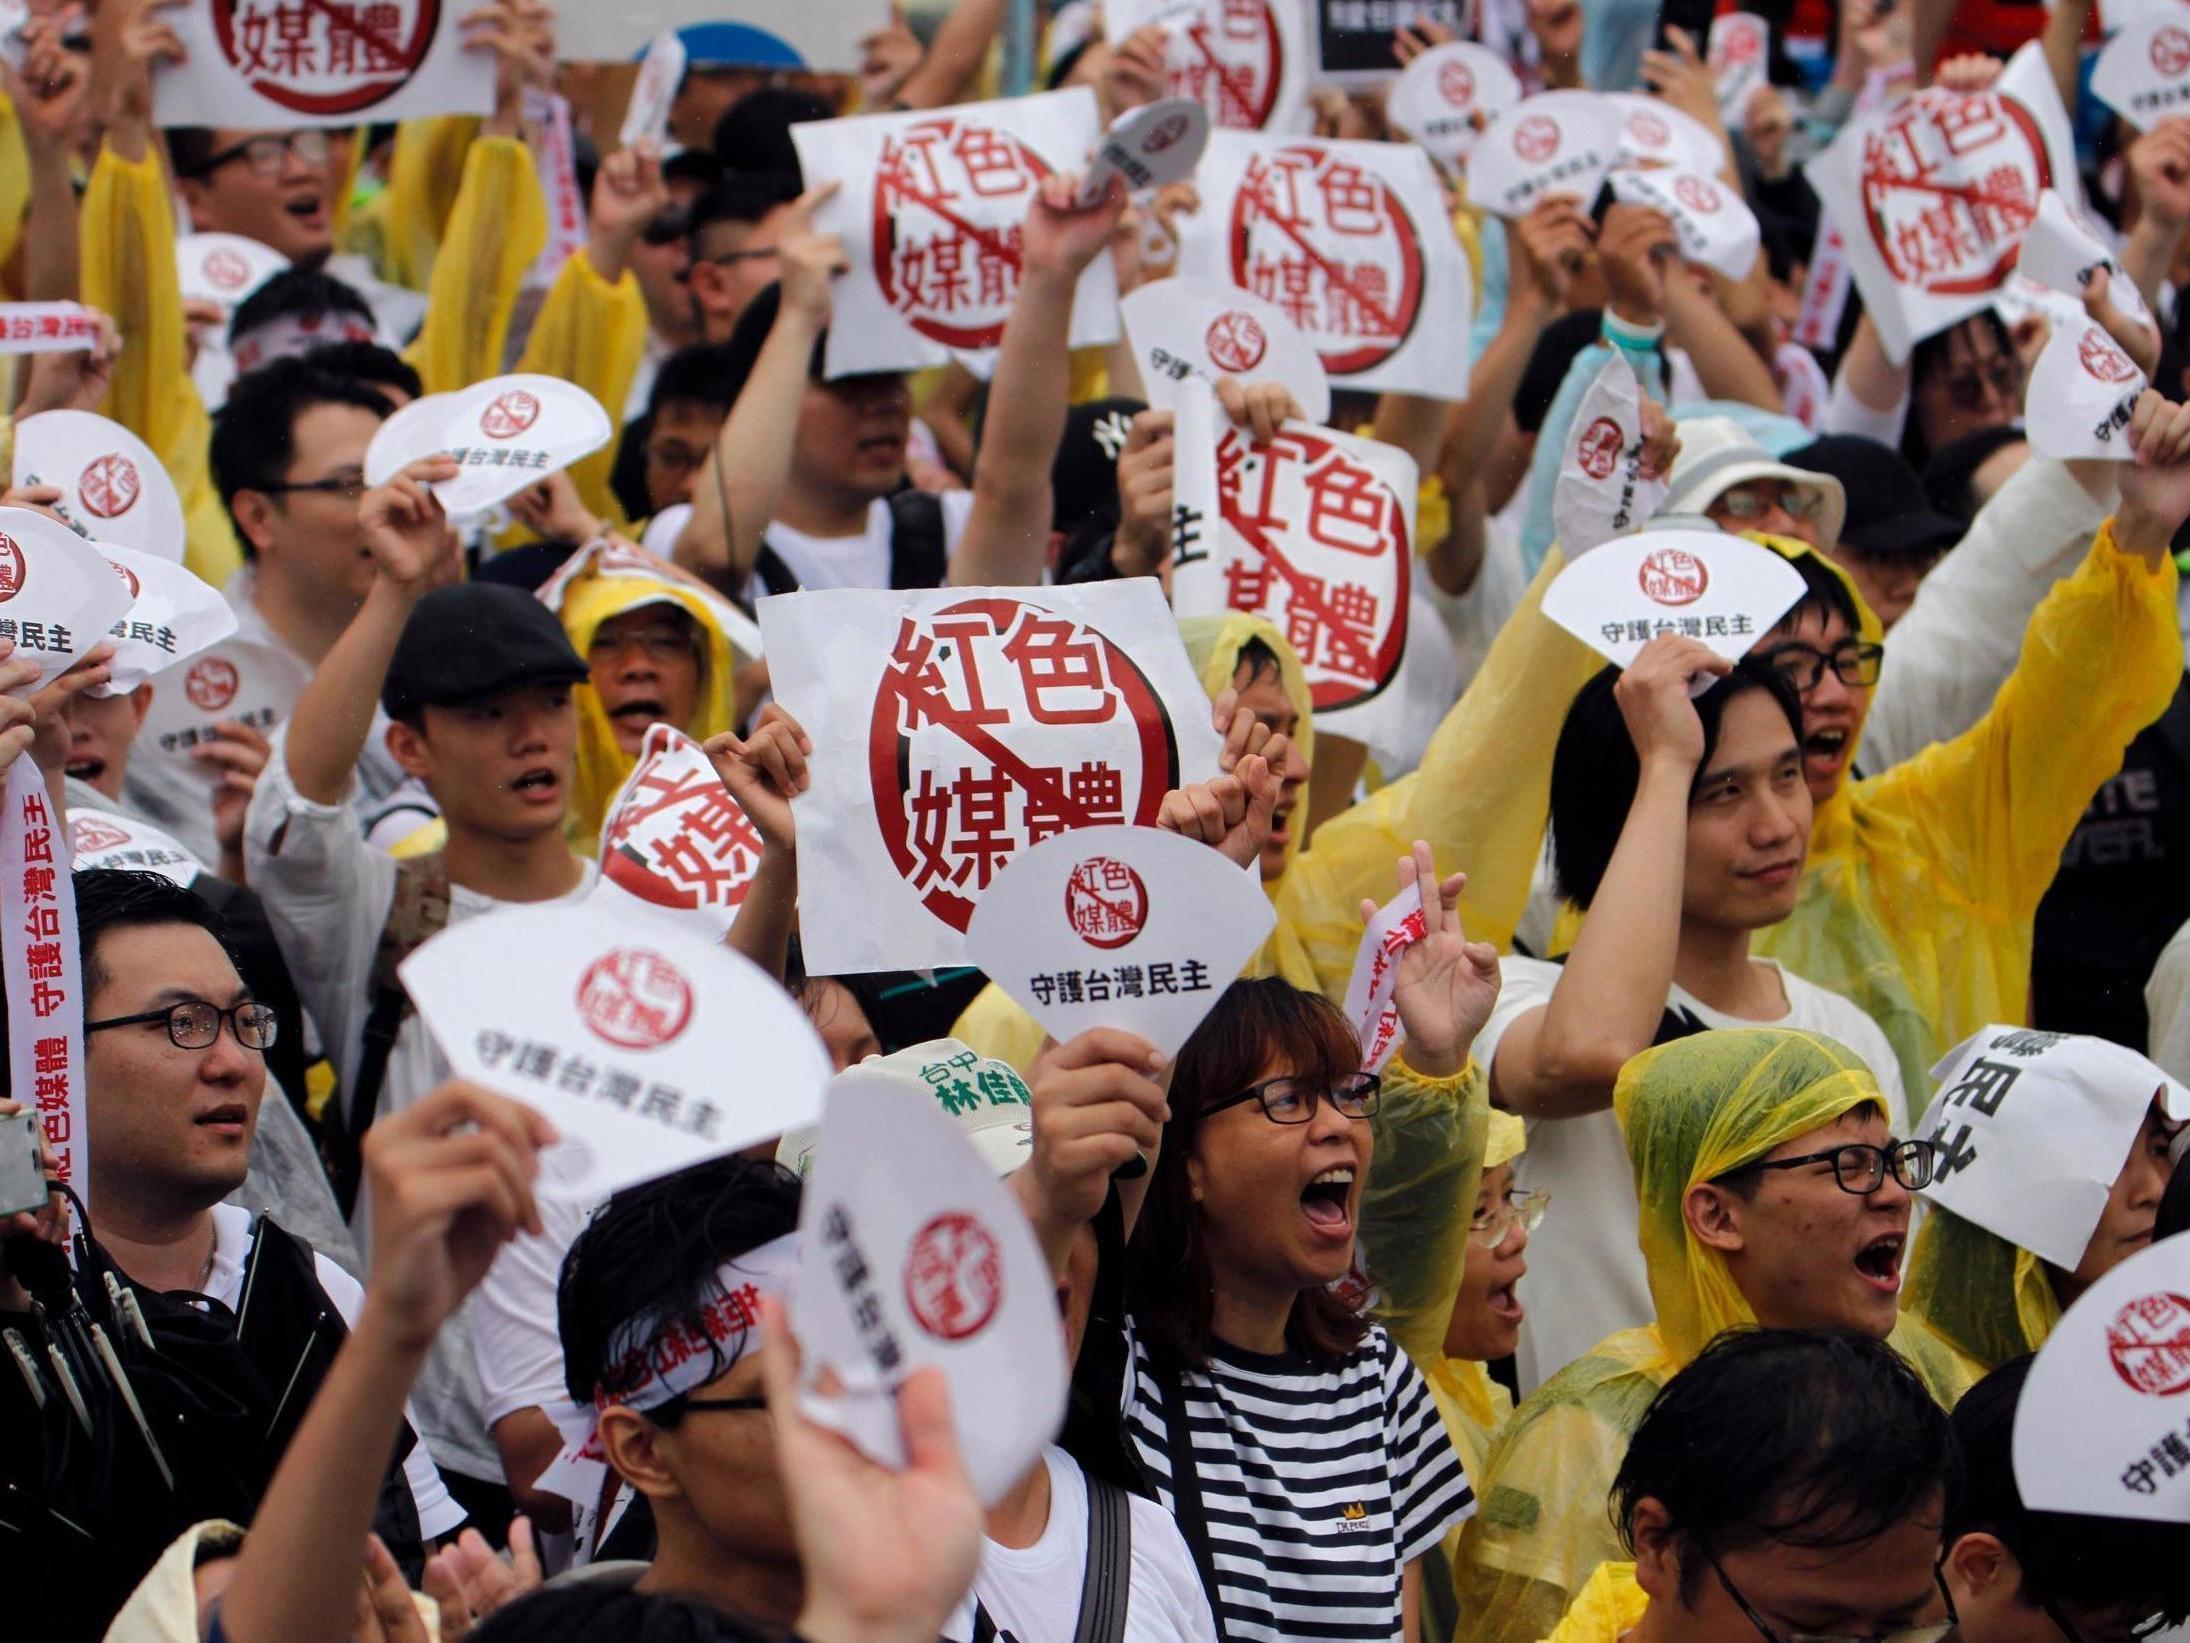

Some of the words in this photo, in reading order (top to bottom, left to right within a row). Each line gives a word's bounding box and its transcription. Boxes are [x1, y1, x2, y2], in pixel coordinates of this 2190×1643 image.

[880, 126, 1030, 208] 紅色
[1244, 153, 1385, 237] 紅色
[1216, 427, 1389, 557] 紅色
[891, 610, 1118, 732] 紅色
[23, 792, 66, 1017] 守護台灣民主
[1071, 860, 1131, 895] 紅色
[1076, 898, 1138, 936] 媒體
[1030, 959, 1212, 1007] 守護台灣民主
[476, 1027, 724, 1142] 守護台灣民主
[919, 1052, 978, 1084] 台中
[2121, 1418, 2190, 1495] 守護
